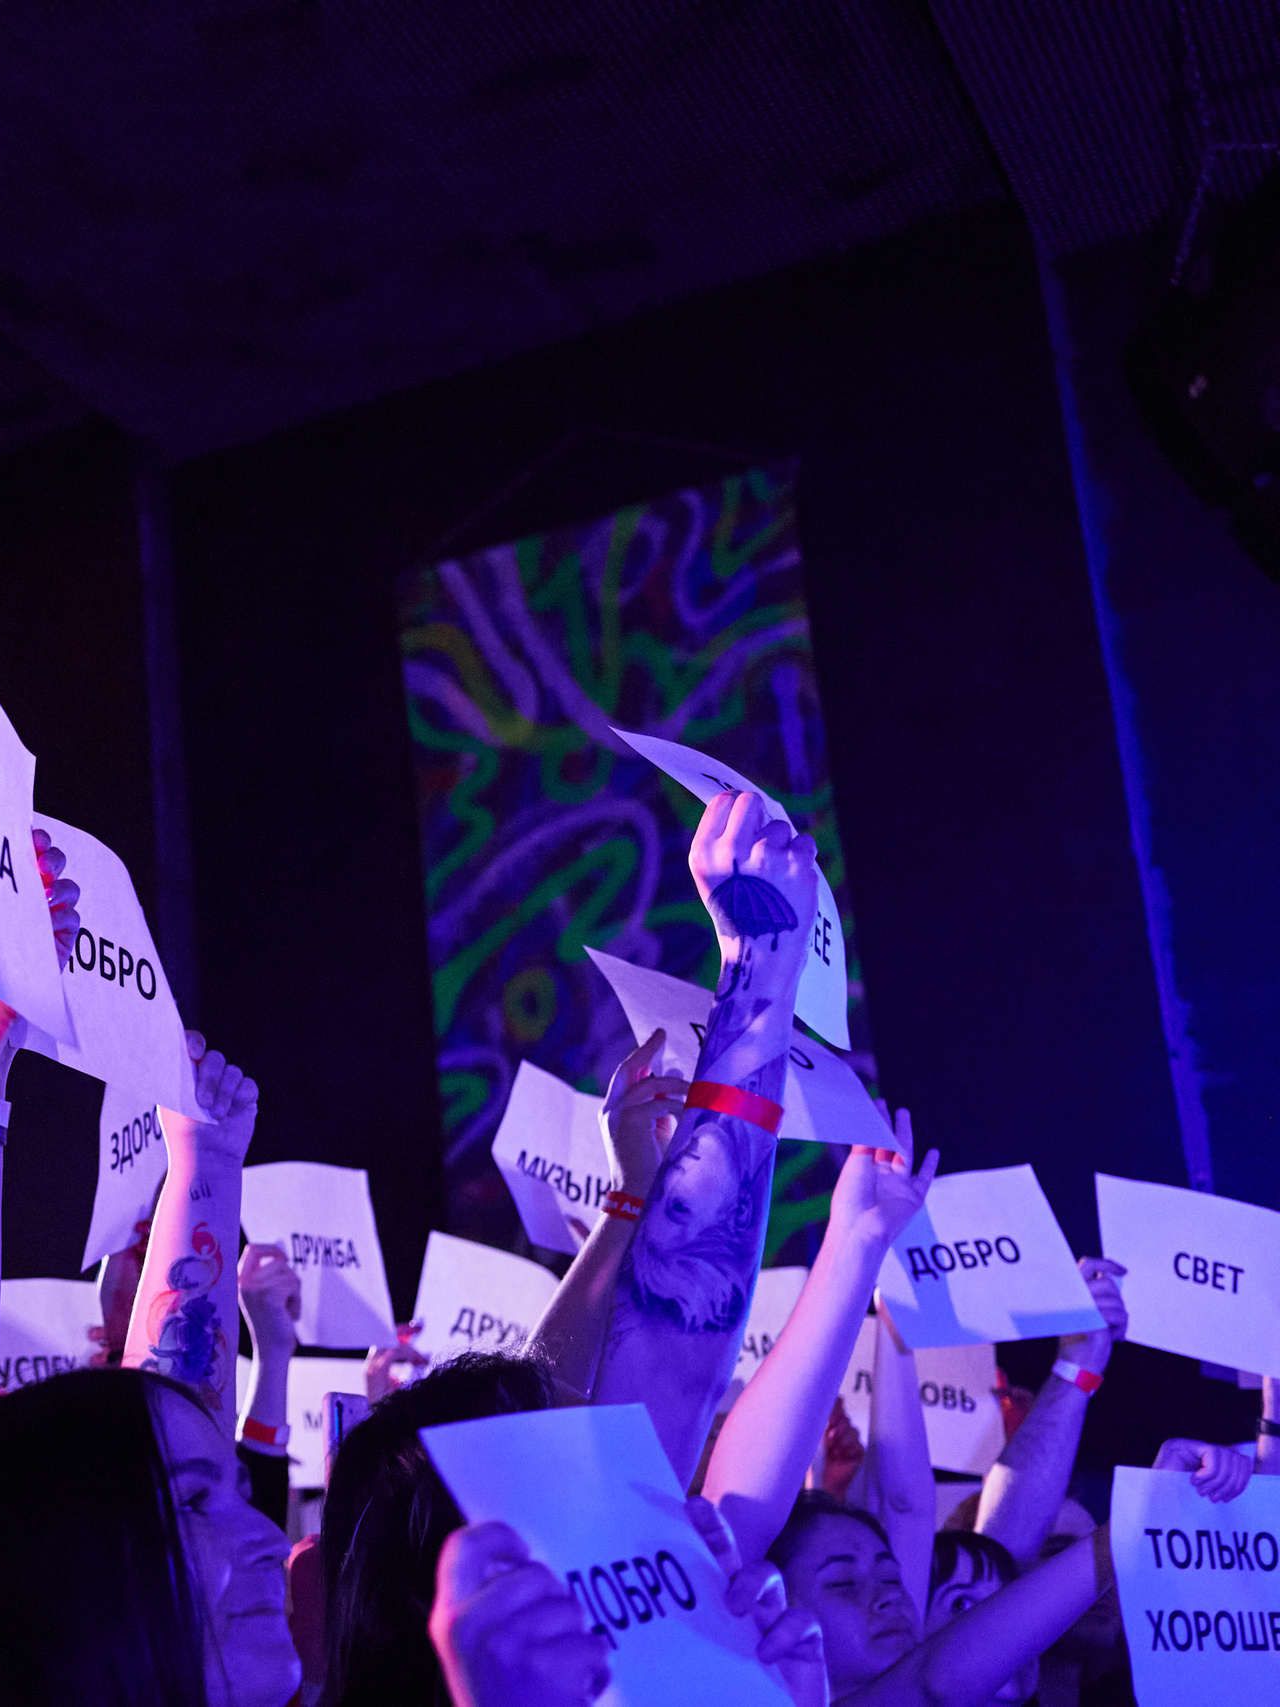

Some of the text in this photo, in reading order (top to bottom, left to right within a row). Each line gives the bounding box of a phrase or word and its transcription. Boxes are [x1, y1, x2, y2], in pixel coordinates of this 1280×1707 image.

[67, 927, 157, 1001] ОБРО
[291, 1232, 362, 1271] ДРУЖБА
[906, 1234, 1021, 1283] ДОБРО
[1173, 1251, 1245, 1295] СВЕТ
[450, 1307, 528, 1345] ДРУ
[1144, 1528, 1280, 1572] ТОЛЬКО
